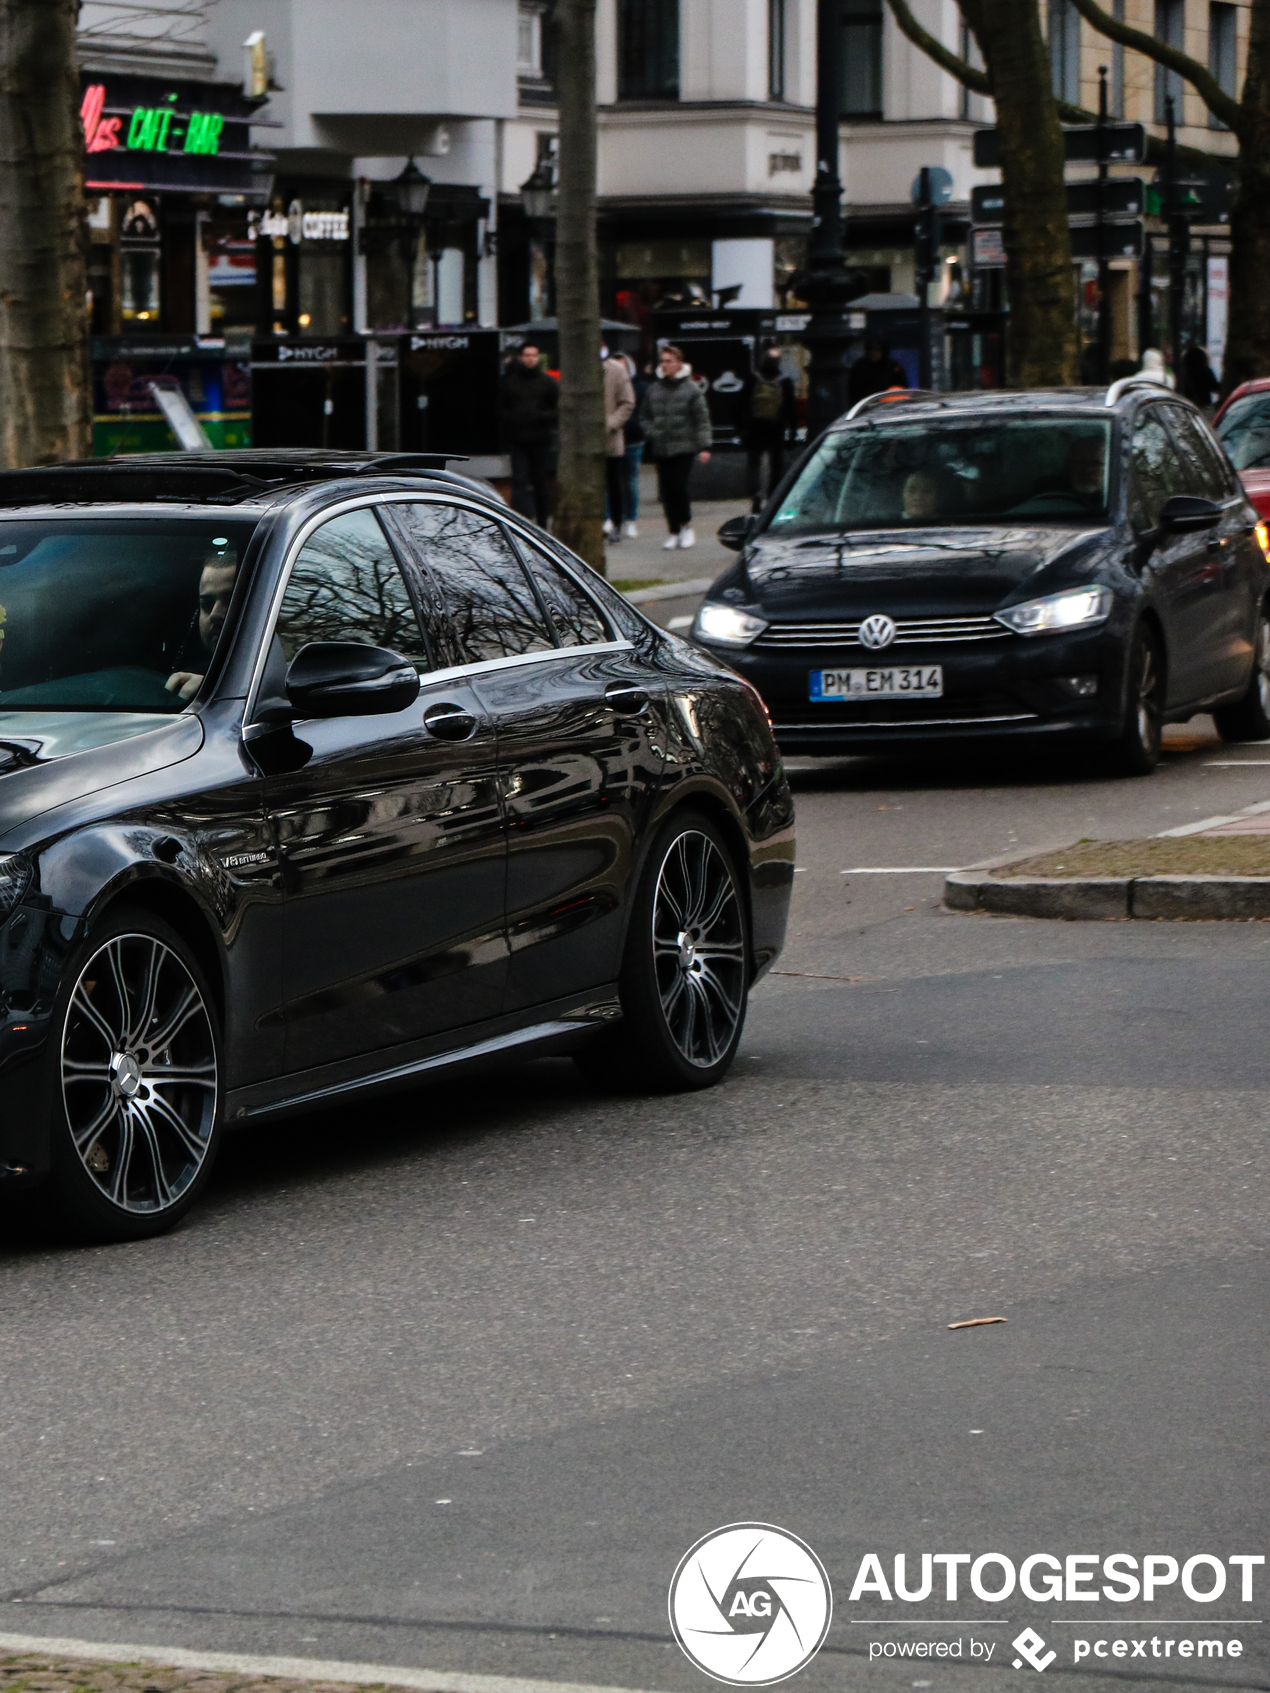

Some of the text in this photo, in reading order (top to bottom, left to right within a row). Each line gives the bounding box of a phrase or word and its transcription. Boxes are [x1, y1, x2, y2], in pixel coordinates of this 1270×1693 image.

[823, 669, 939, 694] PM EM 314
